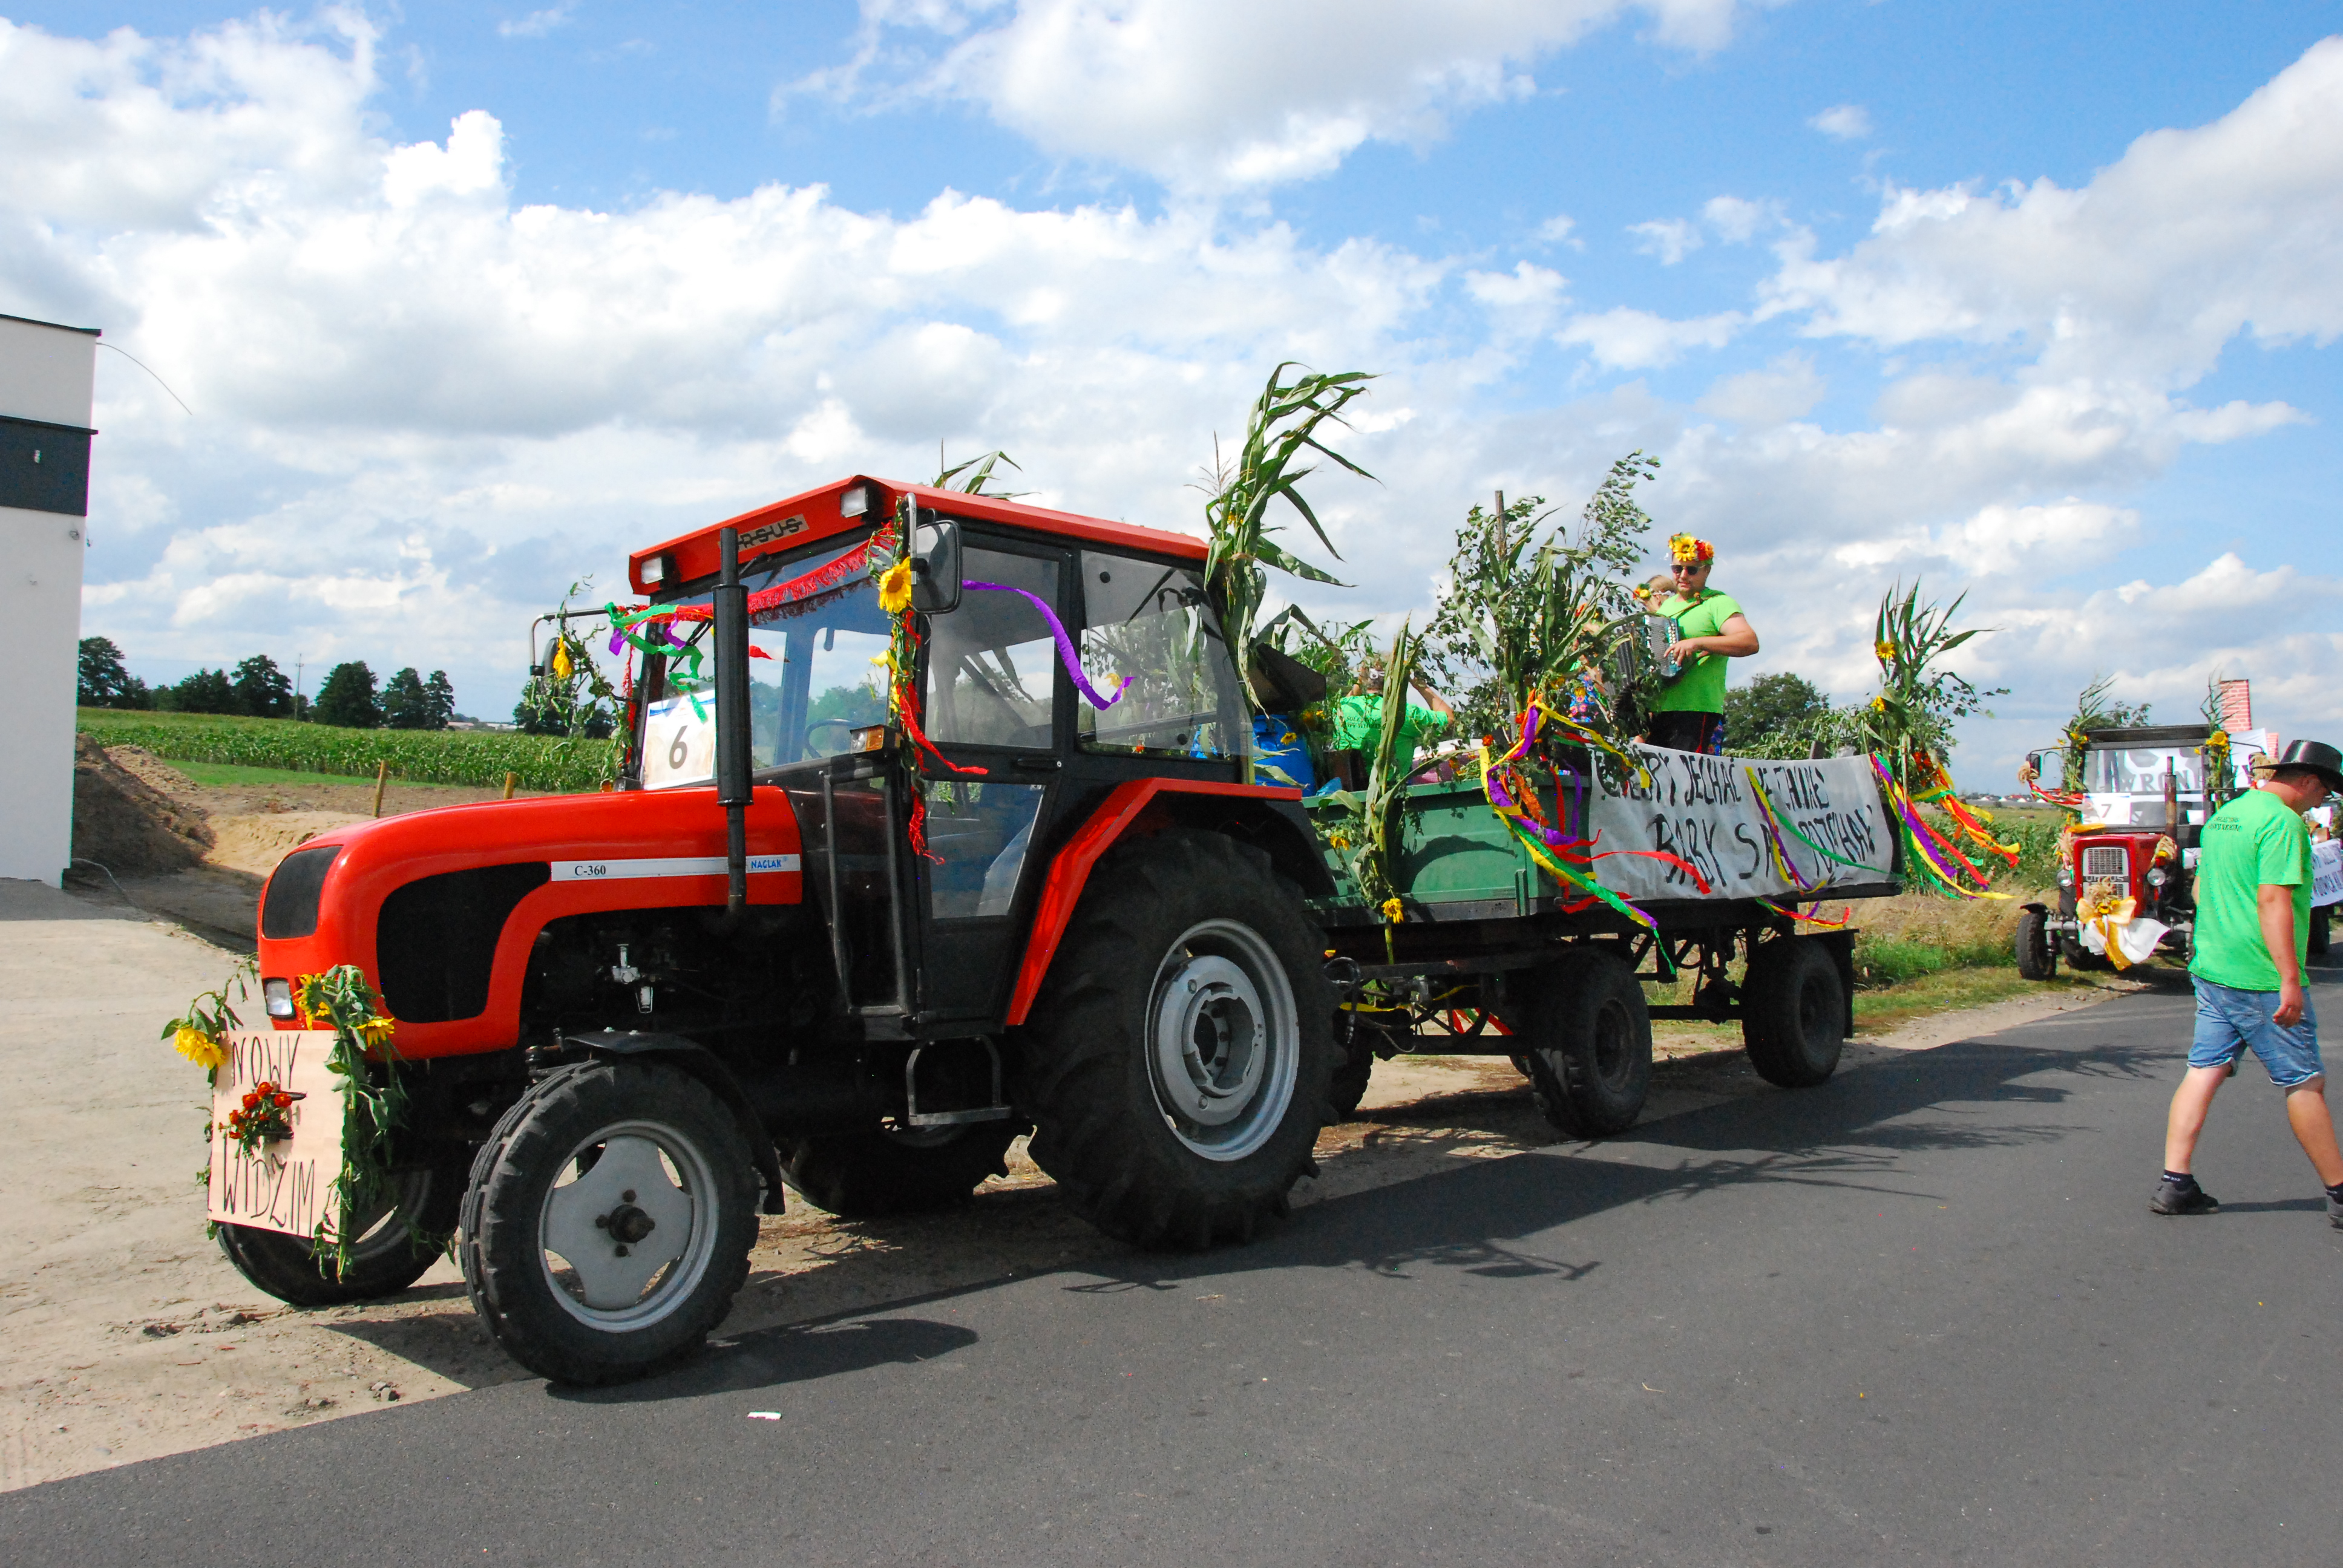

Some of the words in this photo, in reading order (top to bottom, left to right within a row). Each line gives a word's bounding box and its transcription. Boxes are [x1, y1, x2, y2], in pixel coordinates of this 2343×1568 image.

[738, 518, 803, 548] RSUS
[669, 725, 688, 769] 6
[2101, 803, 2112, 818] 7
[574, 865, 606, 876] C-360
[232, 1033, 301, 1089] NOWY
[223, 1132, 315, 1238] WIDZIM
